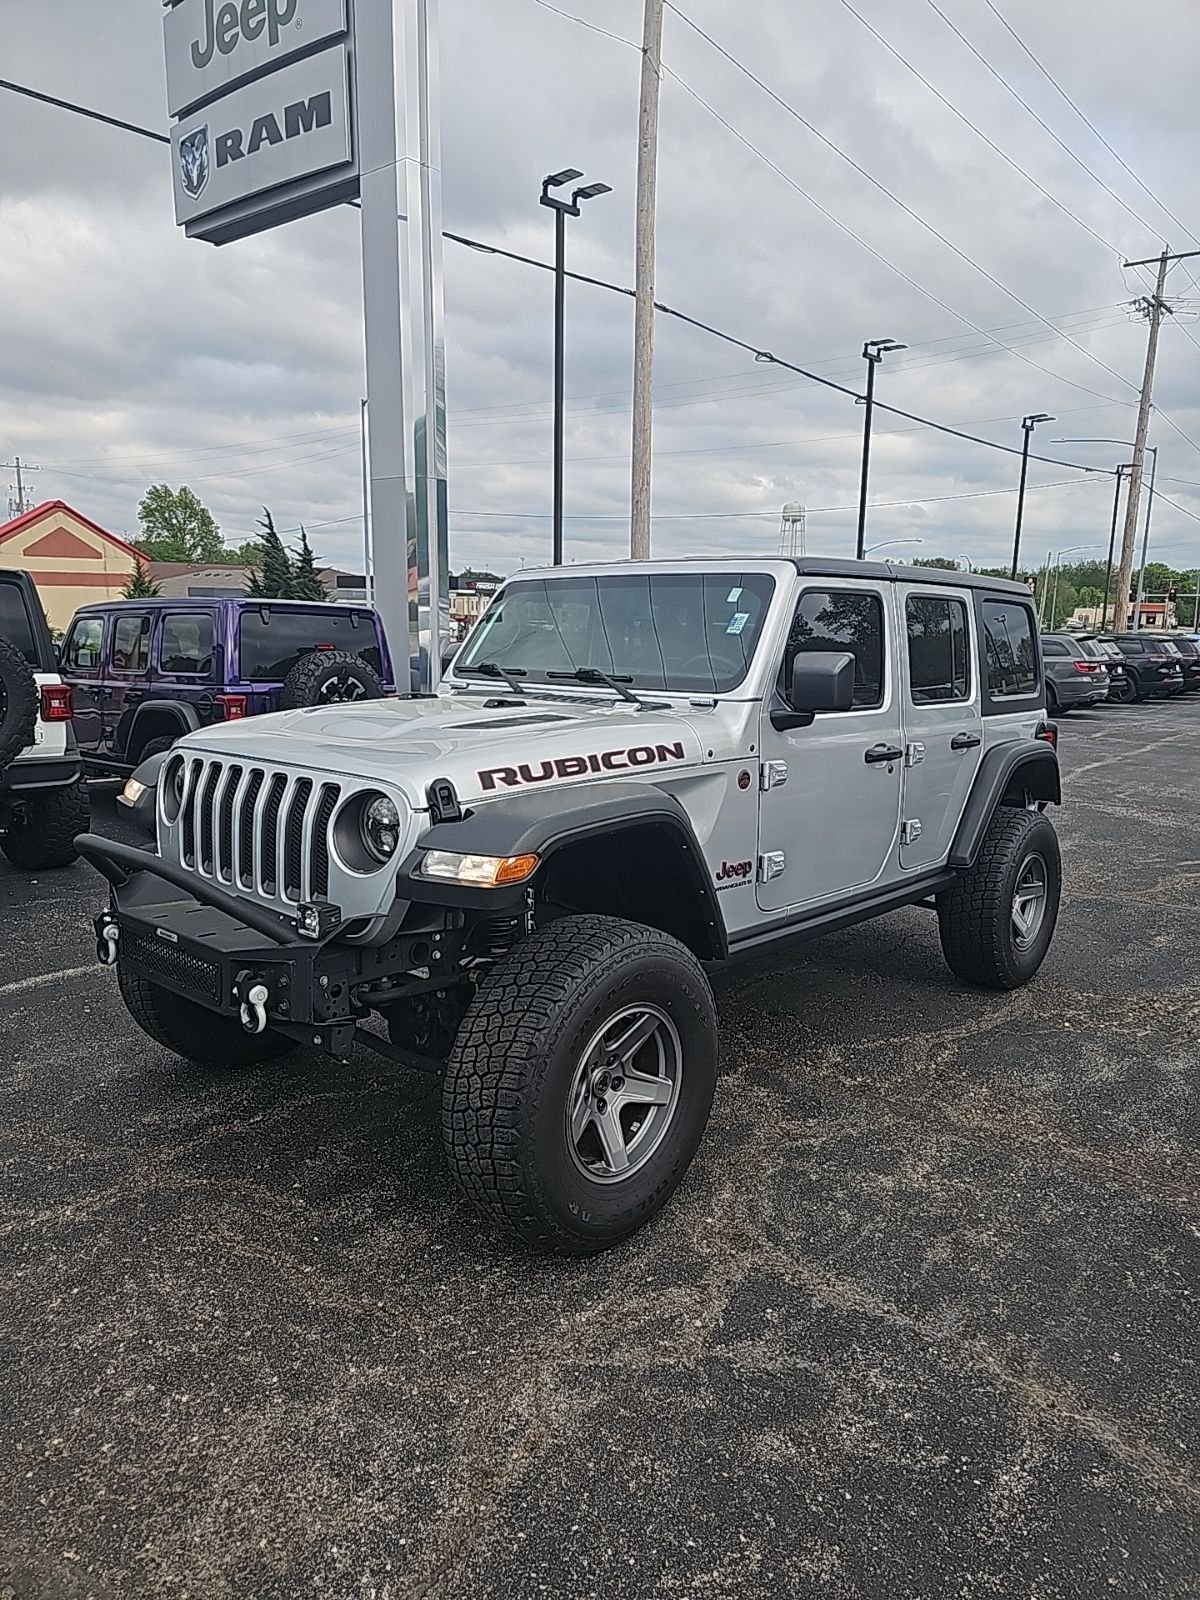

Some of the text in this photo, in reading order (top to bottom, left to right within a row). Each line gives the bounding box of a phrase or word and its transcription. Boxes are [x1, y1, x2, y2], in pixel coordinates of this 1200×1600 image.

[190, 0, 297, 69] Jeep
[215, 90, 332, 168] RAM
[478, 742, 685, 791] RUBICON
[715, 860, 753, 880] Jeep
